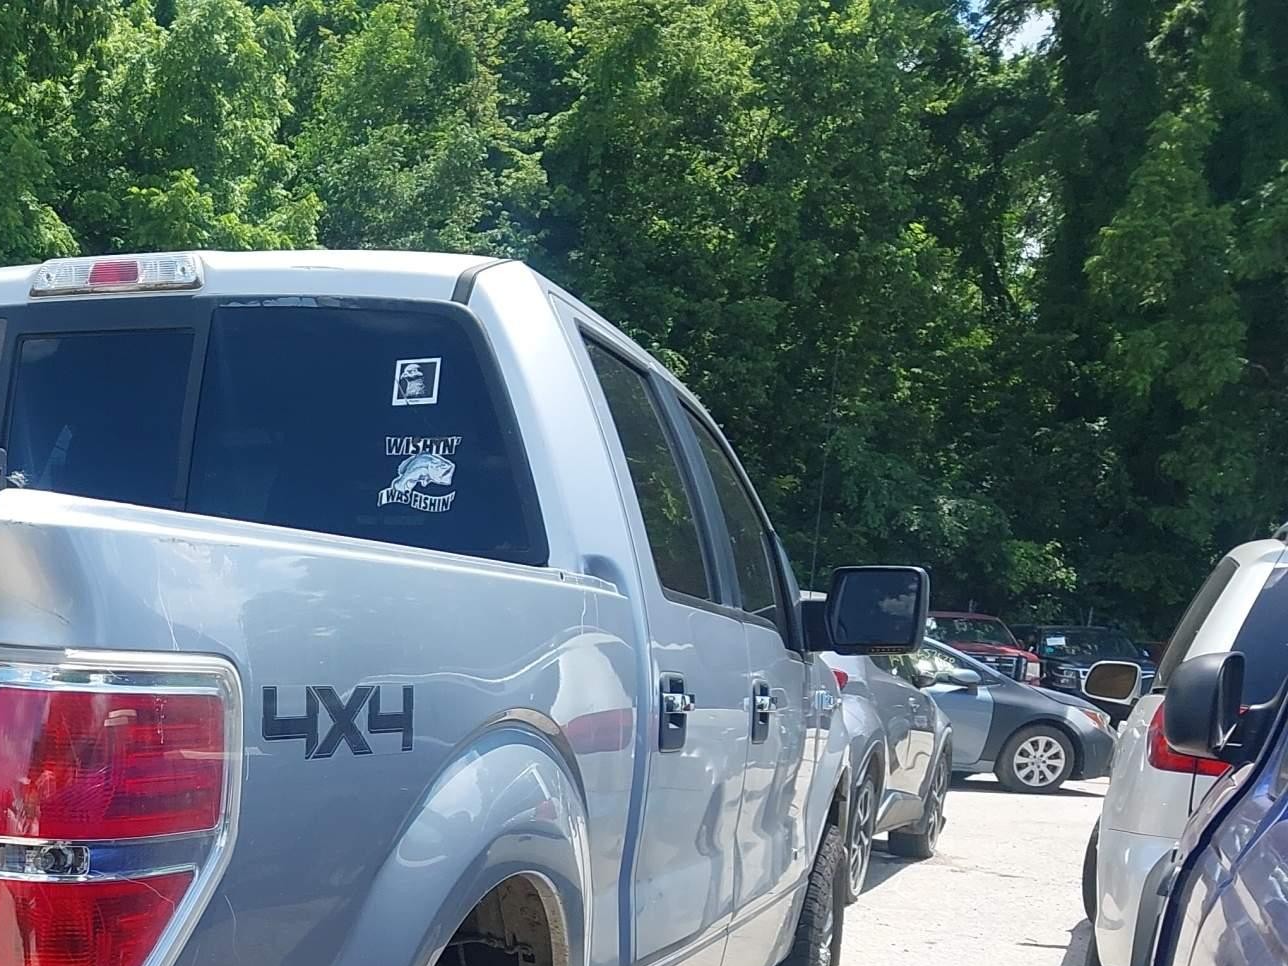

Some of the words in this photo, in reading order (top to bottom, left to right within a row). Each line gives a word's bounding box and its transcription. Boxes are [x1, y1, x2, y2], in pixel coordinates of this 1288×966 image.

[386, 489, 410, 504] WAS
[412, 491, 454, 512] FISHIN'
[262, 684, 414, 760] 4X4
